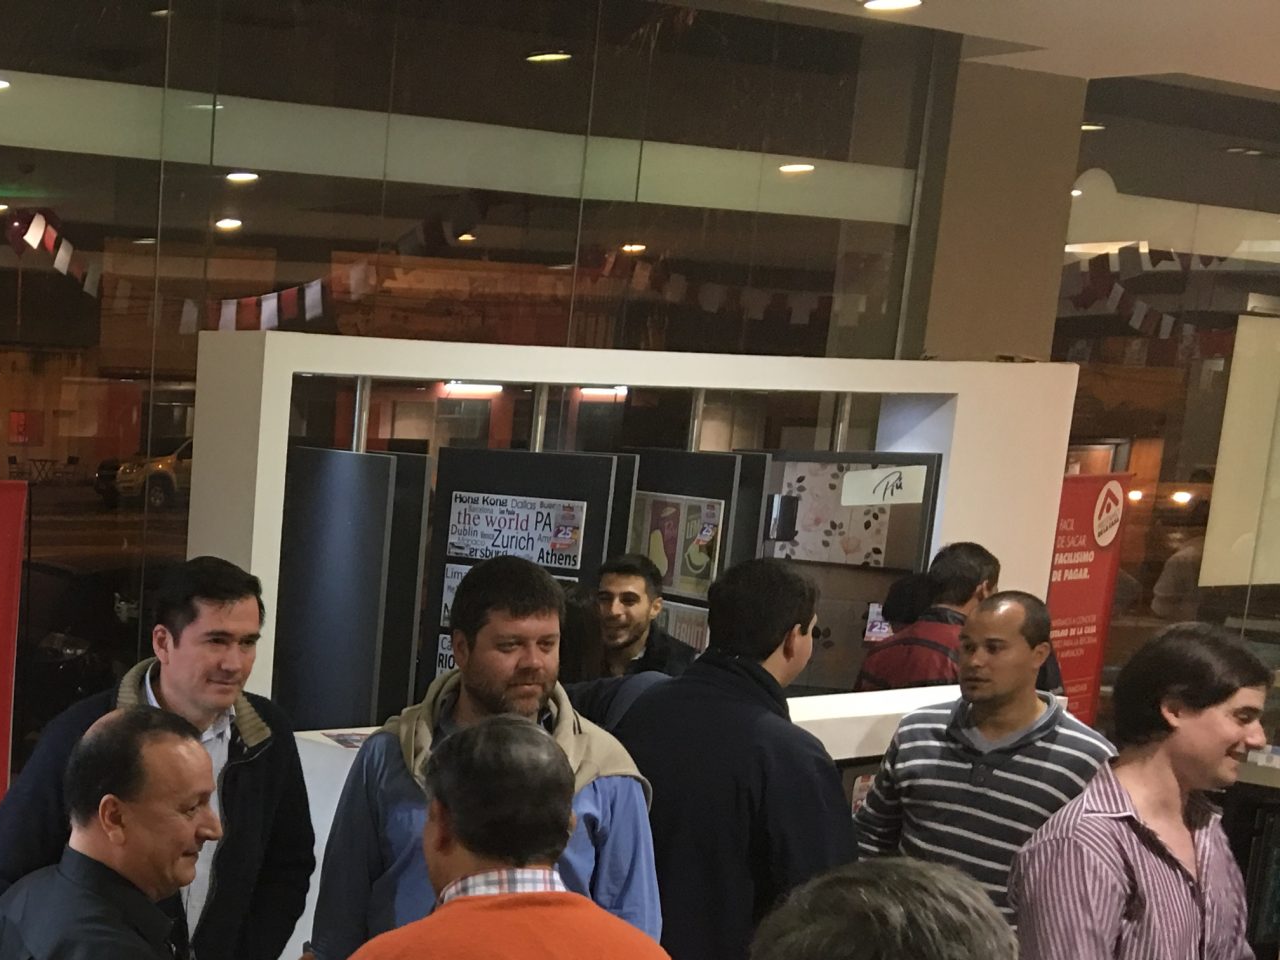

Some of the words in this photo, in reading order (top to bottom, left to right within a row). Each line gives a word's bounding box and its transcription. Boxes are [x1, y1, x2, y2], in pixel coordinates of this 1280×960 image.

[454, 494, 480, 504] Hong
[482, 496, 508, 507] Kong
[511, 499, 536, 510] Dallas
[457, 508, 481, 526] the
[485, 513, 529, 531] world
[451, 524, 478, 537] Dublin
[558, 526, 573, 539] 25
[491, 529, 534, 551] Zurich
[537, 547, 577, 567] Athens
[871, 621, 889, 633] 25
